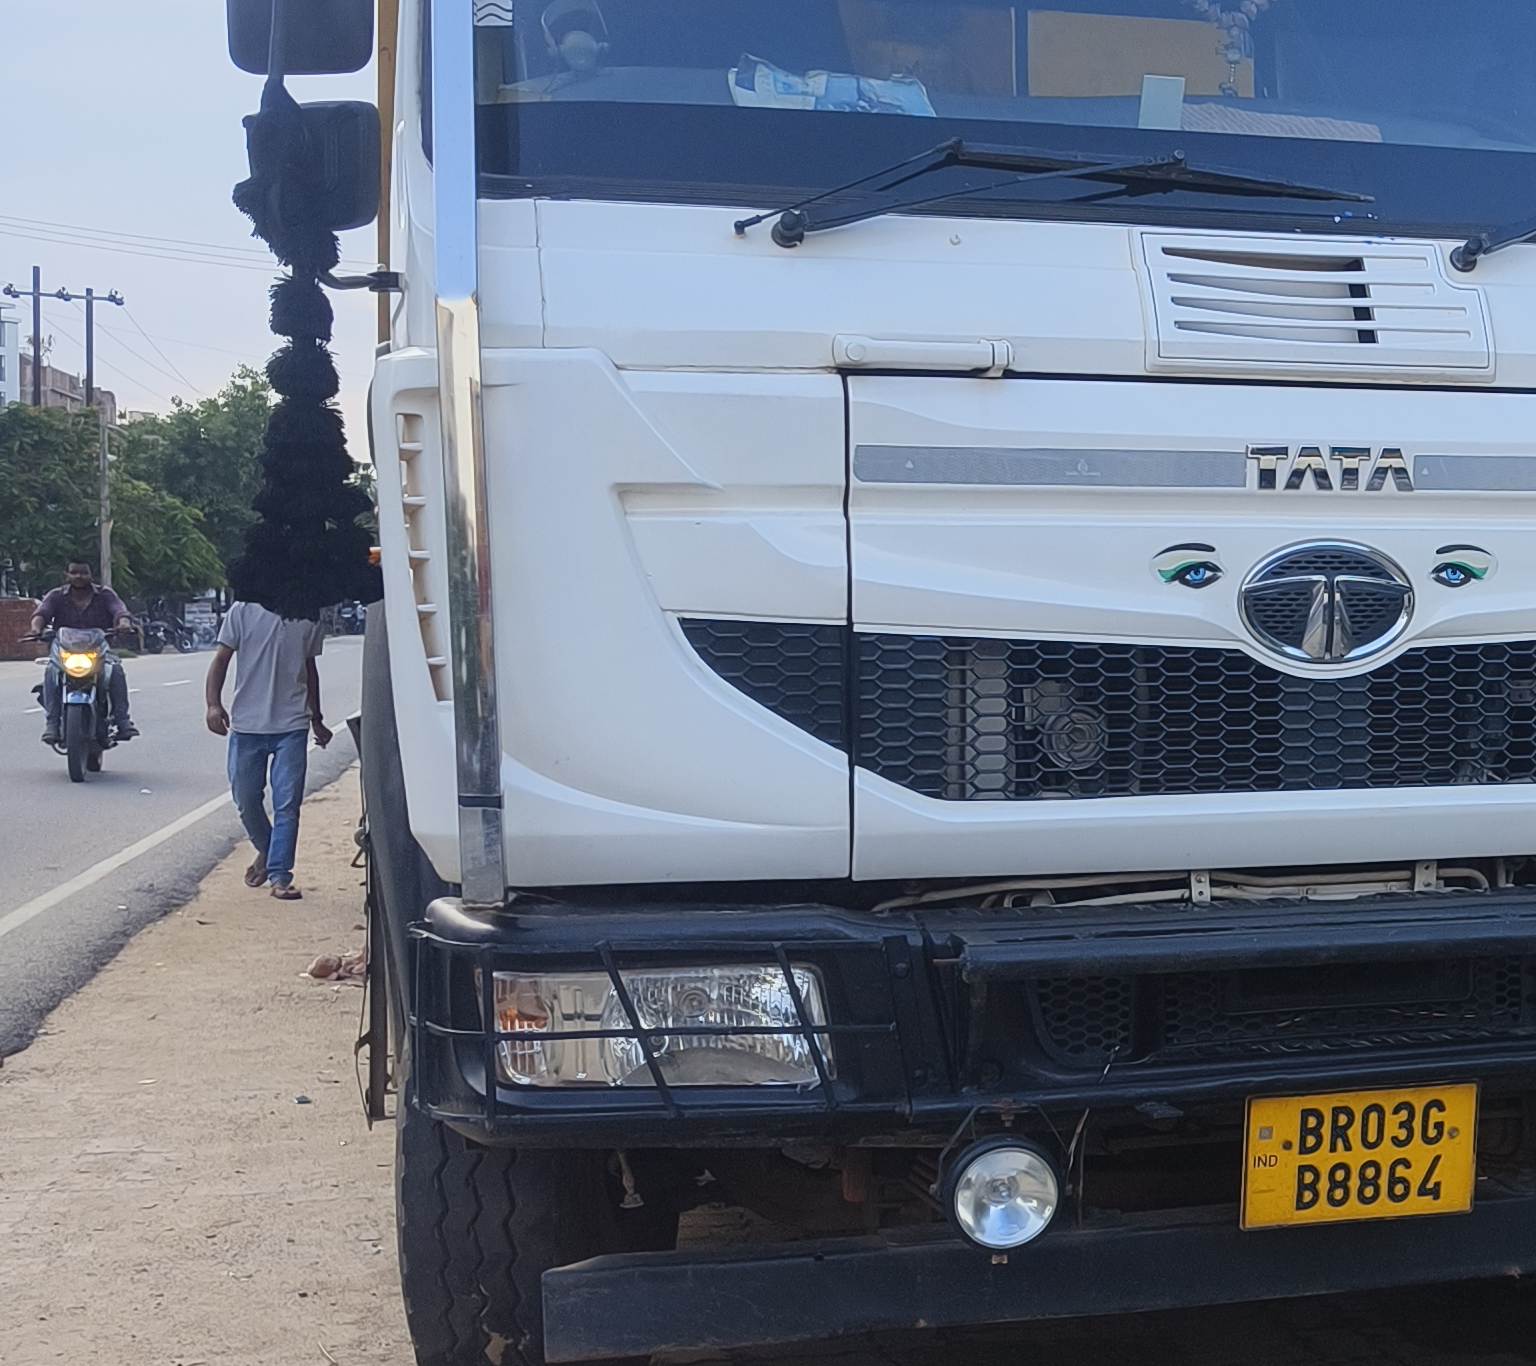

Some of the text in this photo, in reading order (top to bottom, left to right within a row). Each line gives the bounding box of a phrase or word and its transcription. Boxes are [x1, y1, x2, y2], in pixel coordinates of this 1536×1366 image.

[1246, 443, 1414, 491] TATA
[1298, 1098, 1447, 1155] BR03G
[1252, 1154, 1278, 1169] IND
[1295, 1154, 1442, 1211] B8864
